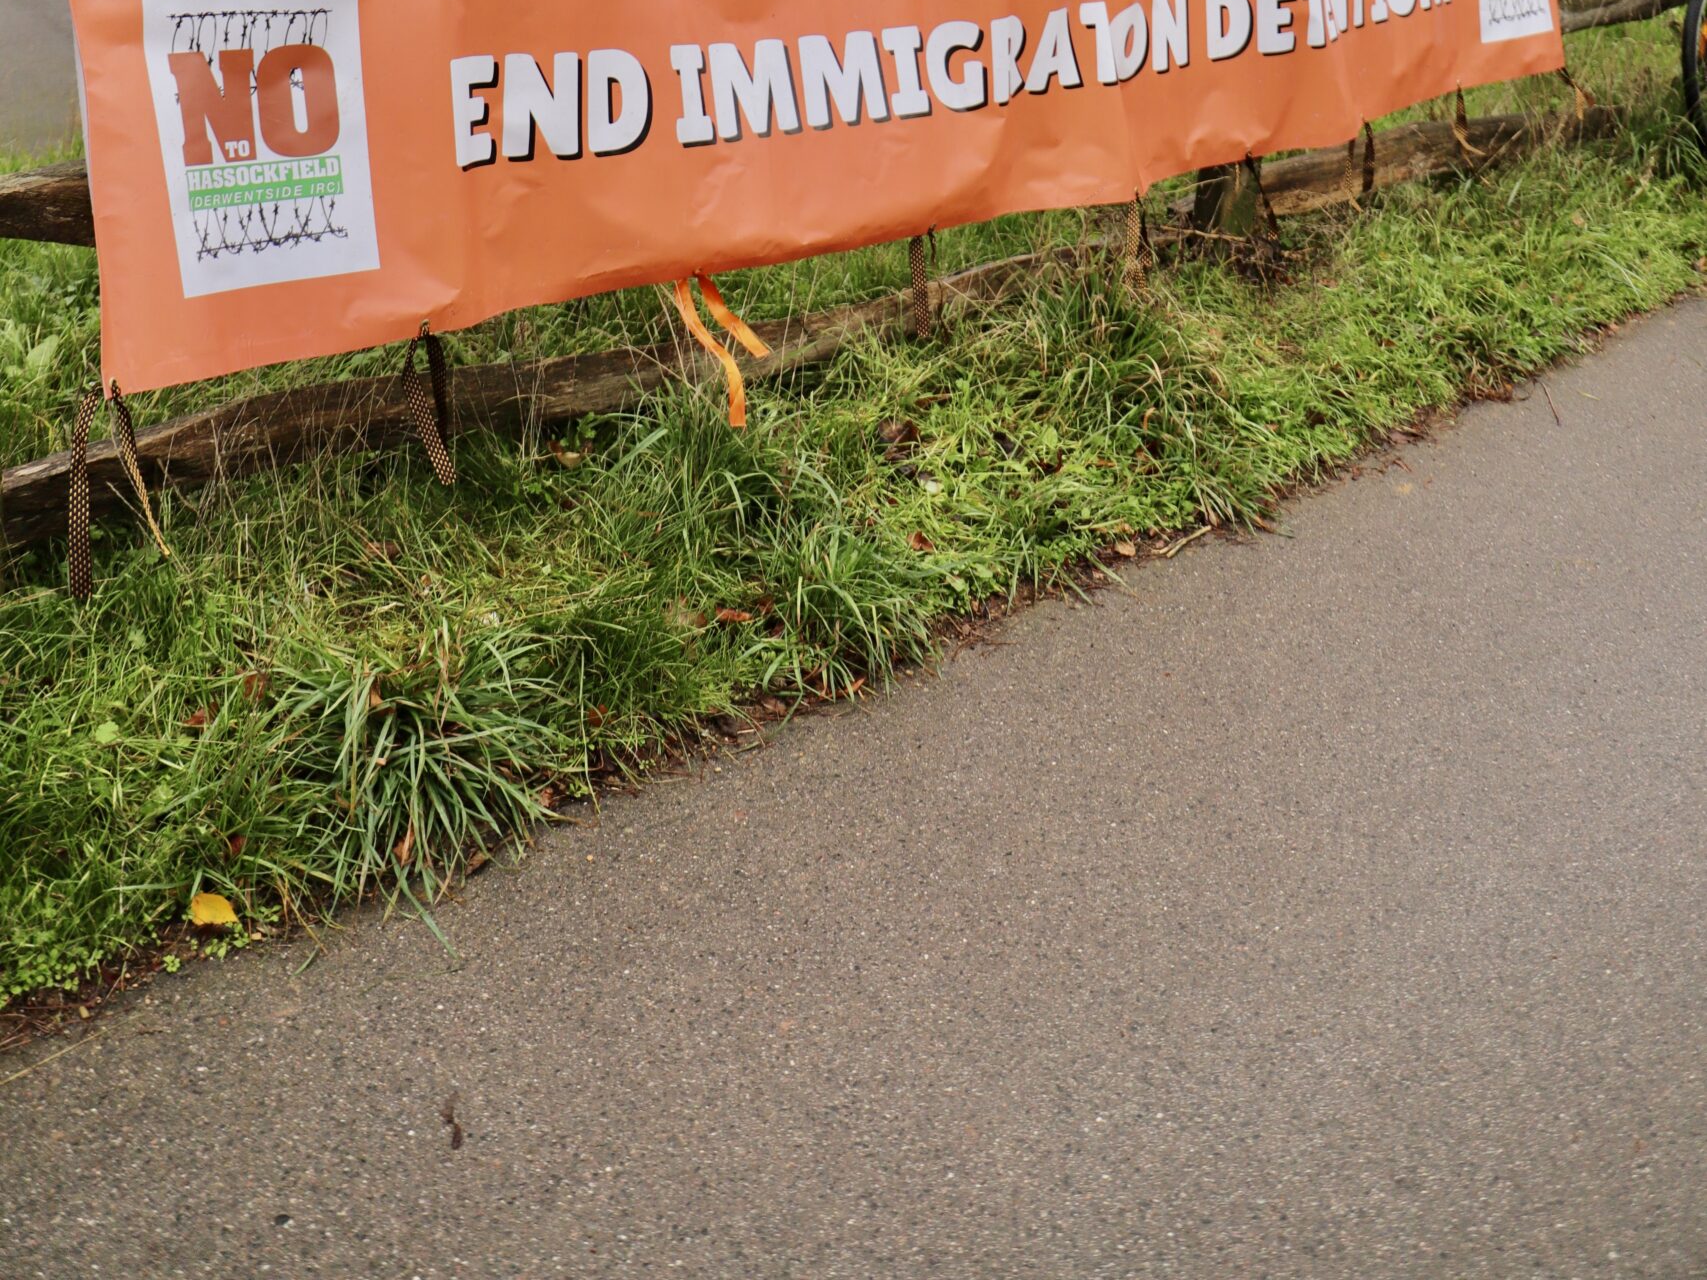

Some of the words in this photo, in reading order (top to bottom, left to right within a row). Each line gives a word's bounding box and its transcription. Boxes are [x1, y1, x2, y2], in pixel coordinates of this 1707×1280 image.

[168, 44, 340, 166] NO
[450, 49, 653, 171] END
[225, 140, 250, 158] TO
[187, 157, 339, 191] HASSOCKFIELD
[190, 185, 303, 208] (DERWENTSIDE
[310, 181, 341, 195] IRC)
